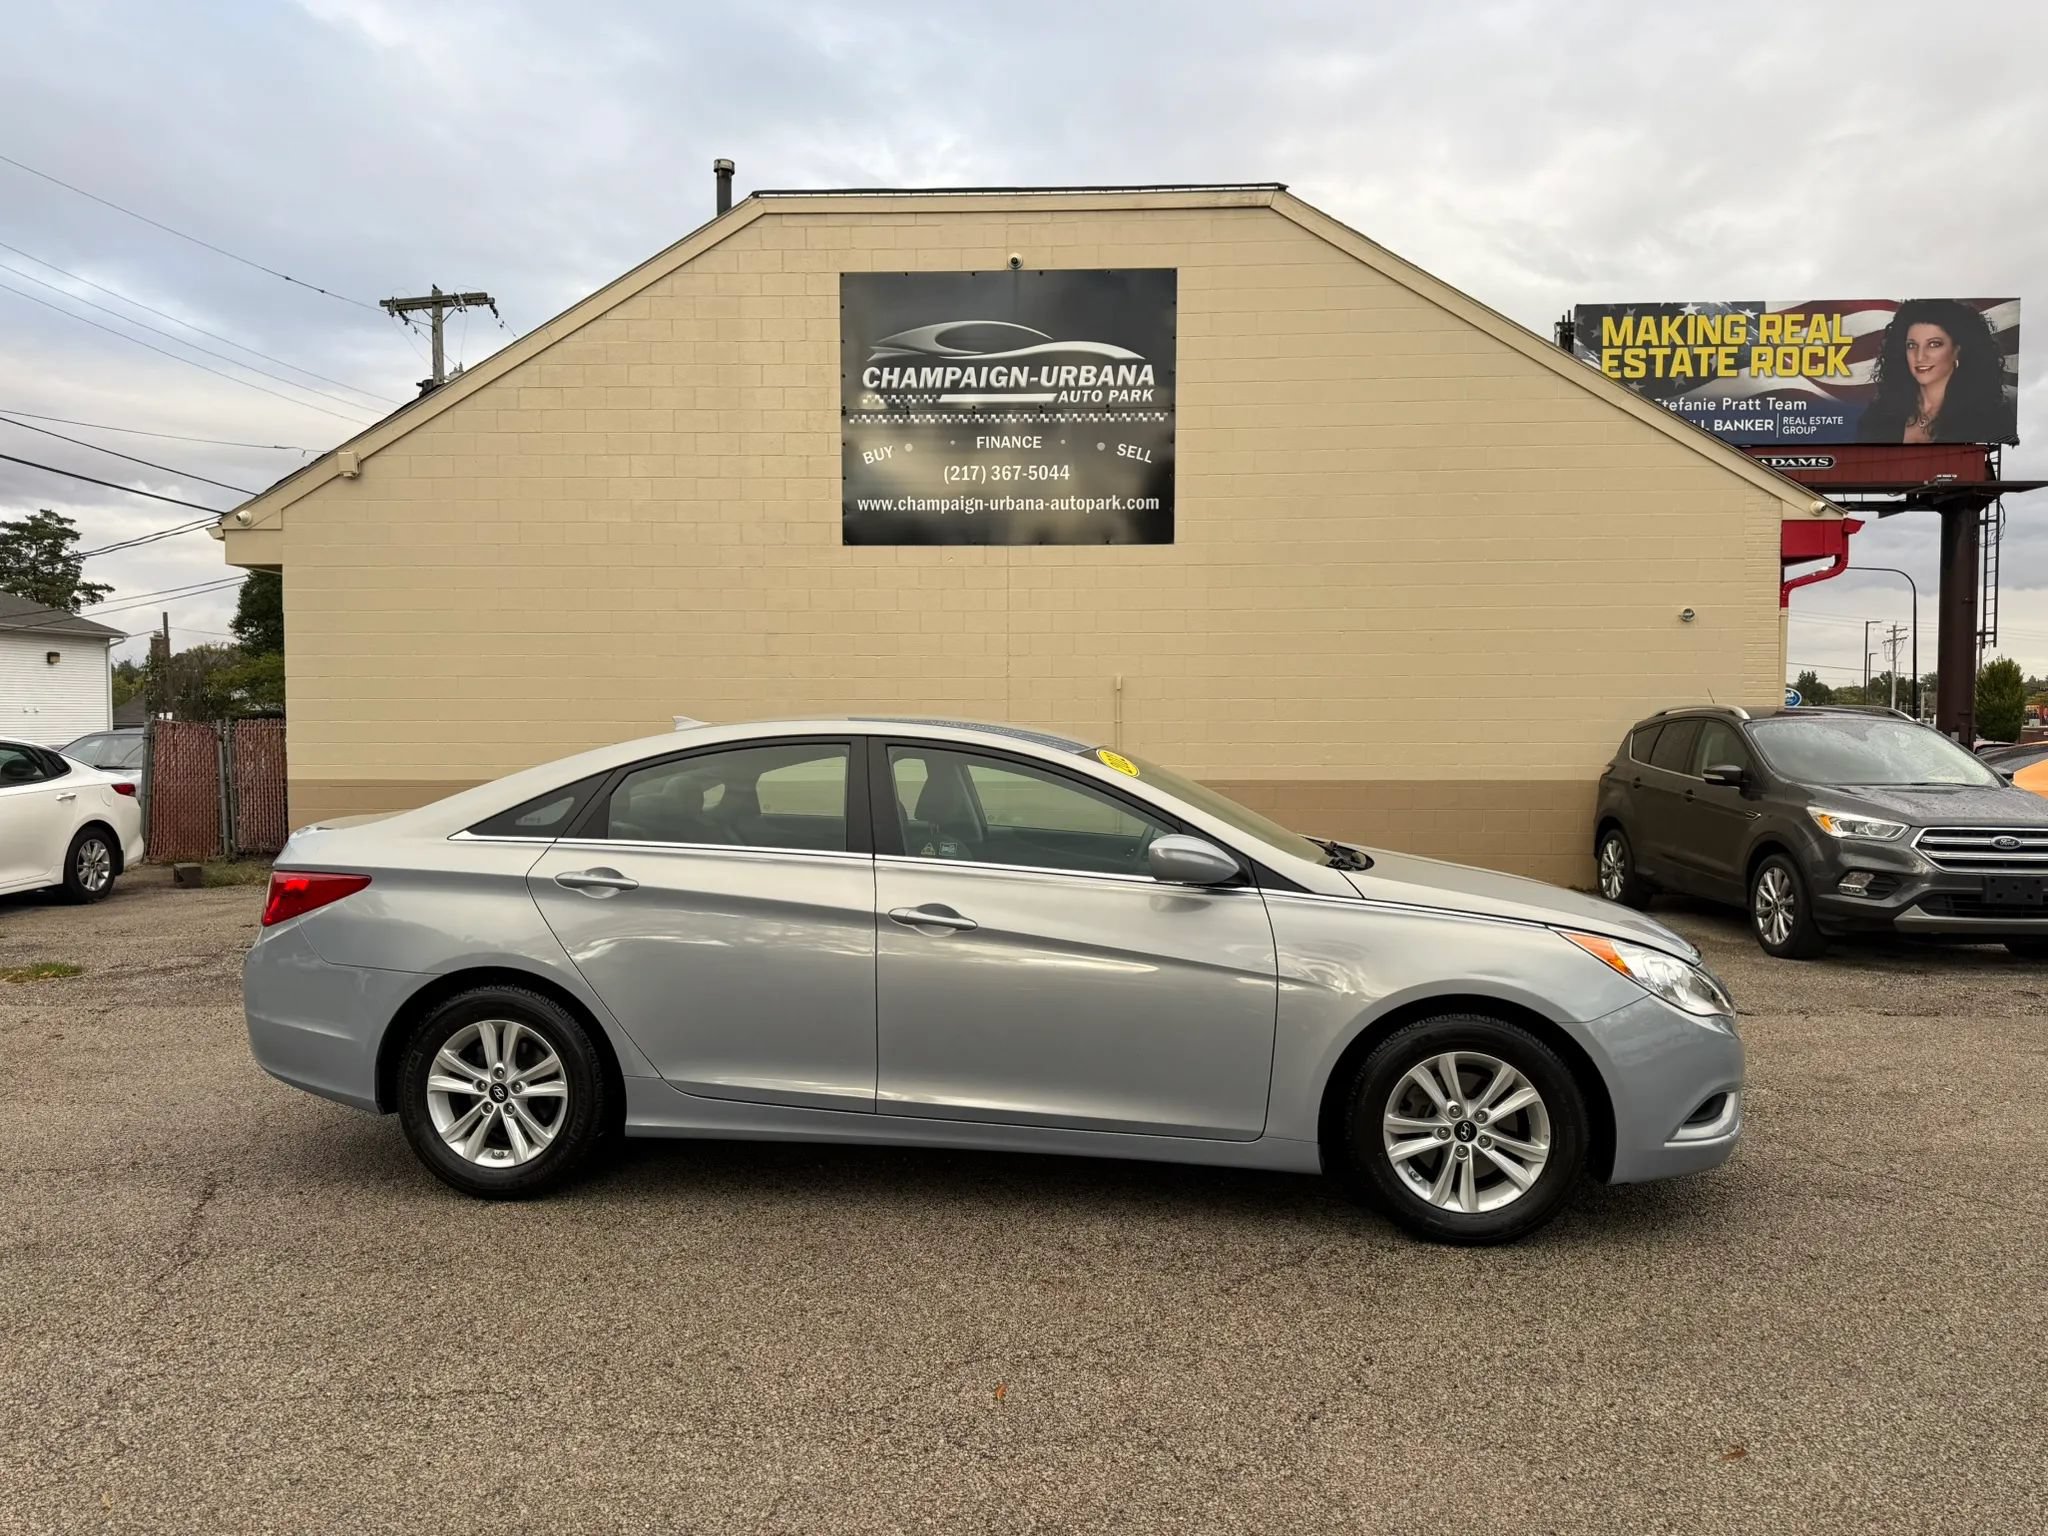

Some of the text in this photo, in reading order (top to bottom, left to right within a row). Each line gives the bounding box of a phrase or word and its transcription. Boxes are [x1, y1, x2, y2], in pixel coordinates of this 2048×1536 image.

[1602, 313, 1853, 346] MAKING REAL
[1601, 346, 1851, 378] ESTATE ROCK
[862, 365, 1155, 389] CHAMPAIGN-URBANA
[1058, 389, 1154, 403] AUTO PARK
[1654, 397, 1807, 411] tefanie Pratt Team
[1714, 419, 1774, 431] BANKER
[1783, 416, 1844, 425] REAL ESTATE
[1783, 426, 1817, 435] GROUP
[976, 436, 1042, 449] FINANCE
[863, 445, 895, 465] BUY
[1116, 443, 1153, 464] SELL
[943, 465, 1070, 485] (217) 367-5044
[857, 496, 1160, 514] www.champaign-urbana-autopark.com
